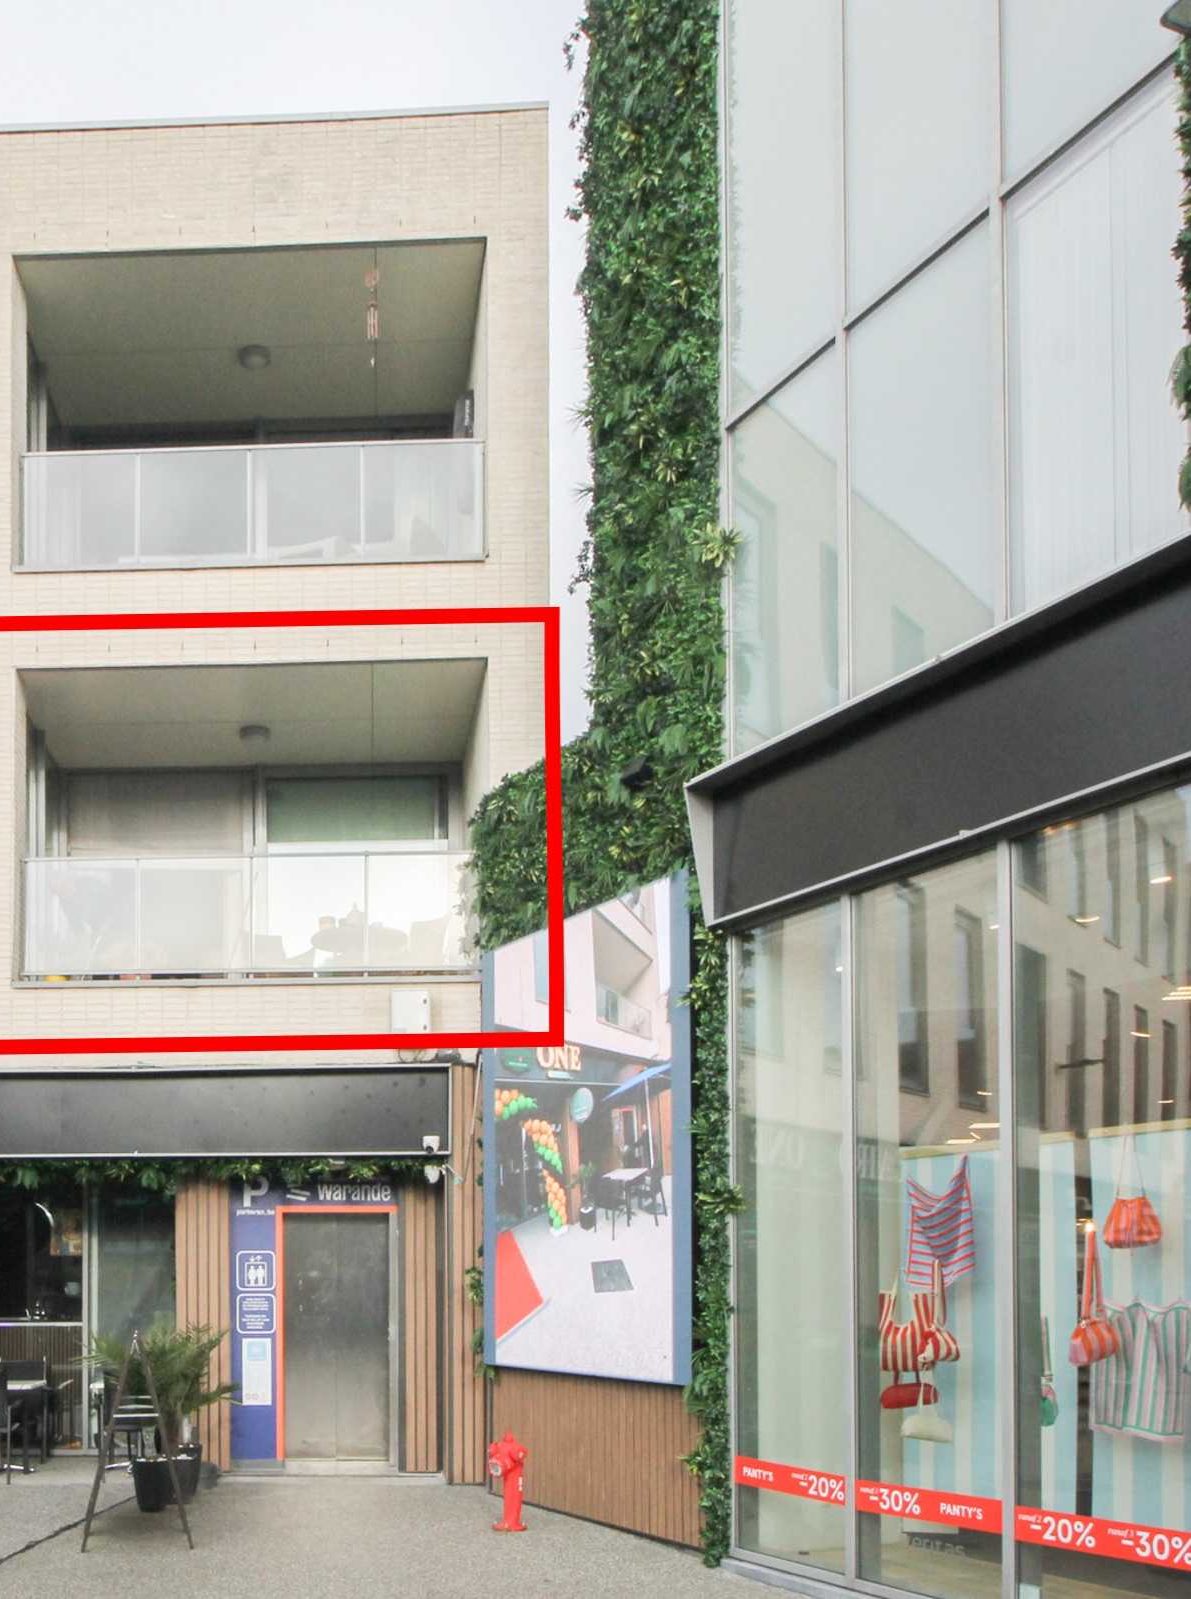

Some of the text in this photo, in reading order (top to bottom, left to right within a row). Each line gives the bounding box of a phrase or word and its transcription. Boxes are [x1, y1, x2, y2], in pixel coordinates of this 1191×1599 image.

[537, 1044, 581, 1071] ONE
[243, 1175, 392, 1208] P warande
[742, 1466, 774, 1481] PANTY'S
[799, 1475, 845, 1501] -20%
[869, 1487, 921, 1515] -30%
[940, 1502, 983, 1520] PANTY'S
[1029, 1515, 1096, 1548] -20%
[1121, 1530, 1191, 1564] -30%
